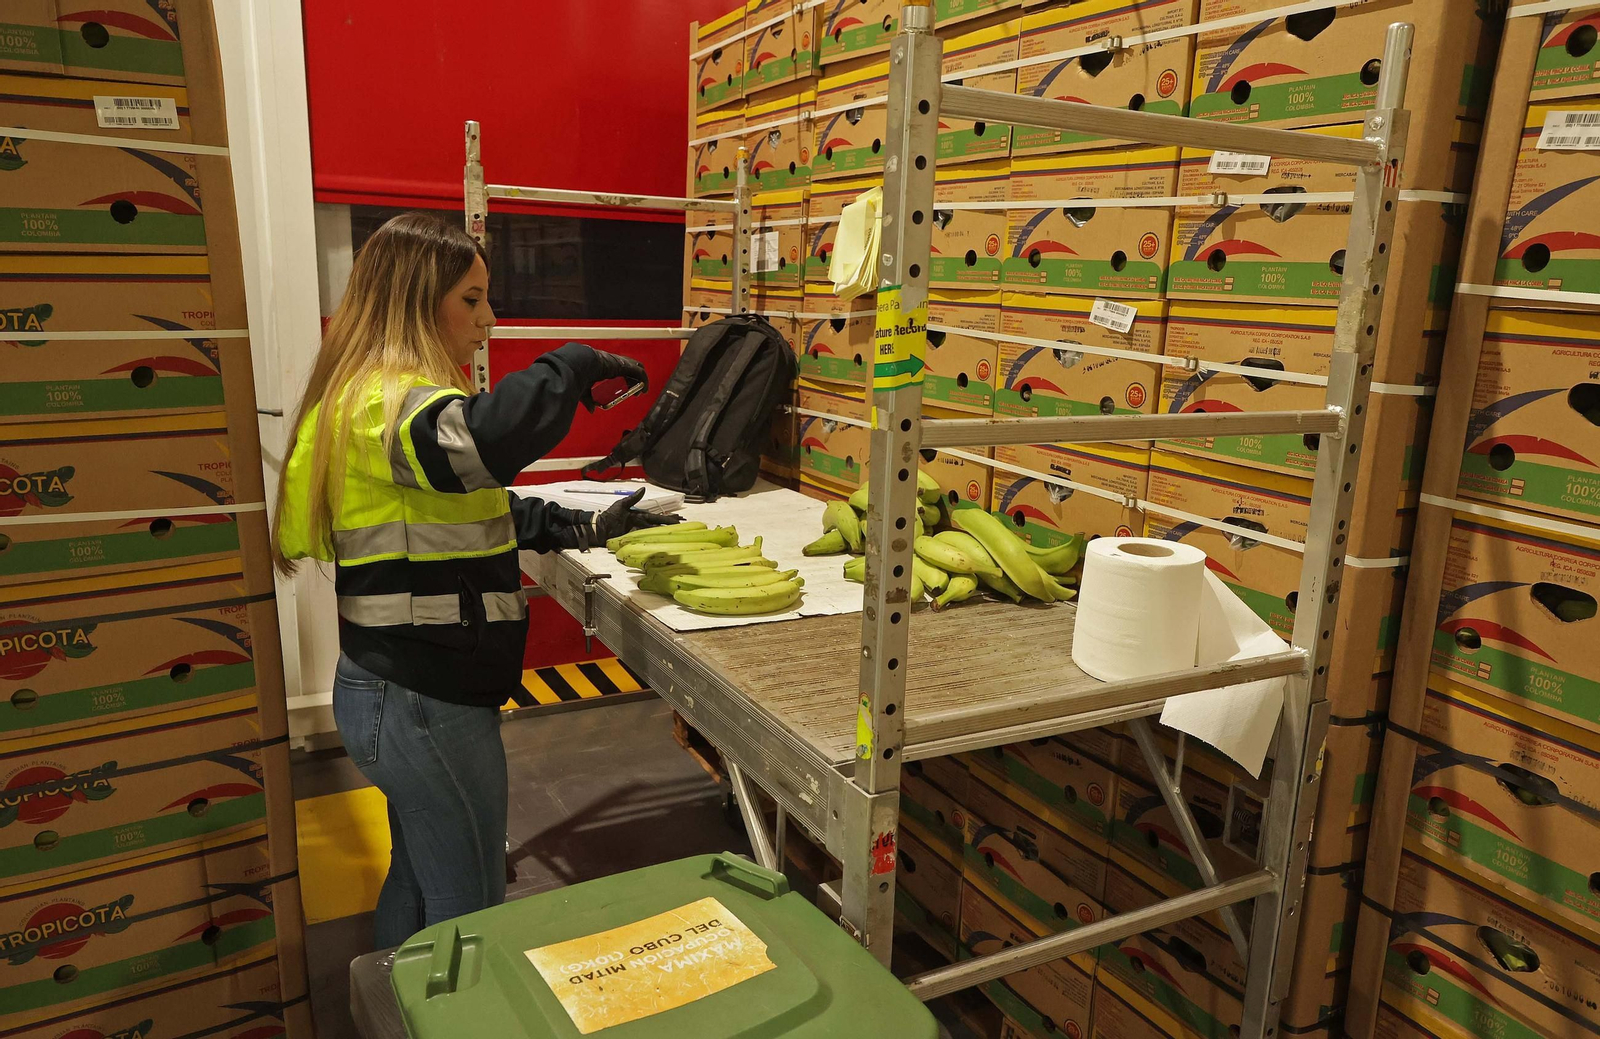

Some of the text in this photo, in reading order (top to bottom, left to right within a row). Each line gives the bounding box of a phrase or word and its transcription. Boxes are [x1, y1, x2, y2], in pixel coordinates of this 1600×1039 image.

[0, 35, 37, 48] 100%
[1161, 77, 1175, 87] 25+
[1288, 84, 1316, 93] PLANTAIN
[1287, 91, 1314, 105] 100%
[1284, 103, 1315, 111] COLOMBIA
[21, 213, 57, 221] PLANTAIN
[22, 219, 59, 231] 100%
[21, 230, 61, 238] COLOMBIA
[1143, 240, 1156, 249] 25+
[1065, 268, 1082, 278] 100%
[1261, 266, 1288, 274] PLANTAIN
[1260, 273, 1286, 285] 100%
[182, 311, 215, 320] TROPI
[1552, 349, 1593, 359] AGRICULTURA
[46, 390, 82, 402] 100%
[1130, 389, 1142, 398] 25+
[1239, 437, 1262, 449] 100%
[1565, 482, 1600, 498] 100%
[70, 545, 104, 558] 100%
[1515, 545, 1553, 561] AGRICULTURA
[0, 628, 89, 657] PICOTA
[1530, 666, 1566, 684] PLANTAIN
[1528, 674, 1563, 695] 100%
[92, 692, 125, 705] 100%
[1523, 684, 1564, 703] COLOMBIA
[1483, 721, 1521, 742] AGRICULTURA
[1542, 739, 1583, 763] CORPORATION
[114, 830, 145, 843] 100%
[1495, 849, 1529, 873] 100%
[0, 905, 126, 951] TROPICOTA
[560, 918, 723, 975] DEL CUBO (10KG)
[568, 927, 731, 985] OCUPACIÓN MITAD
